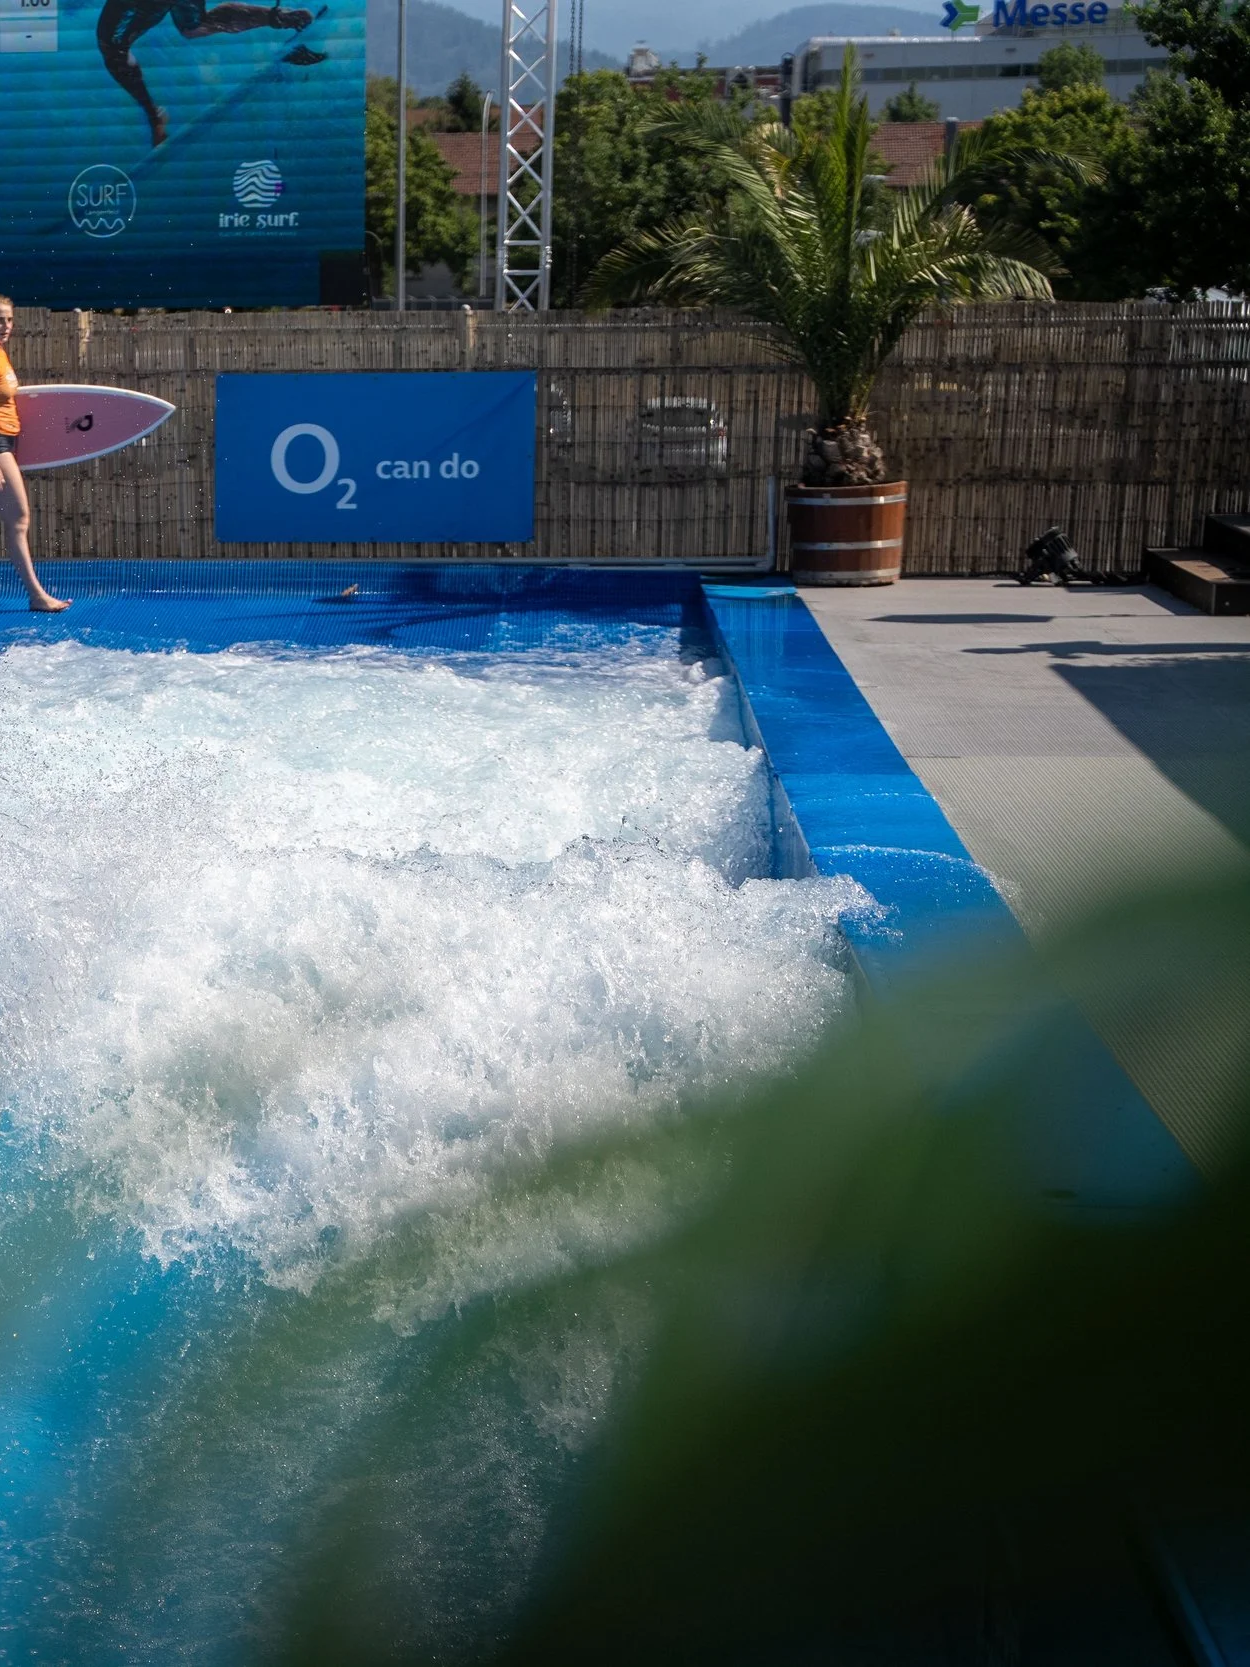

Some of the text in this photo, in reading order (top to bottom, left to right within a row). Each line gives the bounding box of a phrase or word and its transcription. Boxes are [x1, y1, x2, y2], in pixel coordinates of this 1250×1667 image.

[992, 0, 1109, 27] Messe
[76, 183, 129, 207] SURF
[218, 212, 299, 229] irie surf.
[376, 460, 430, 479] can
[439, 453, 480, 479] do
